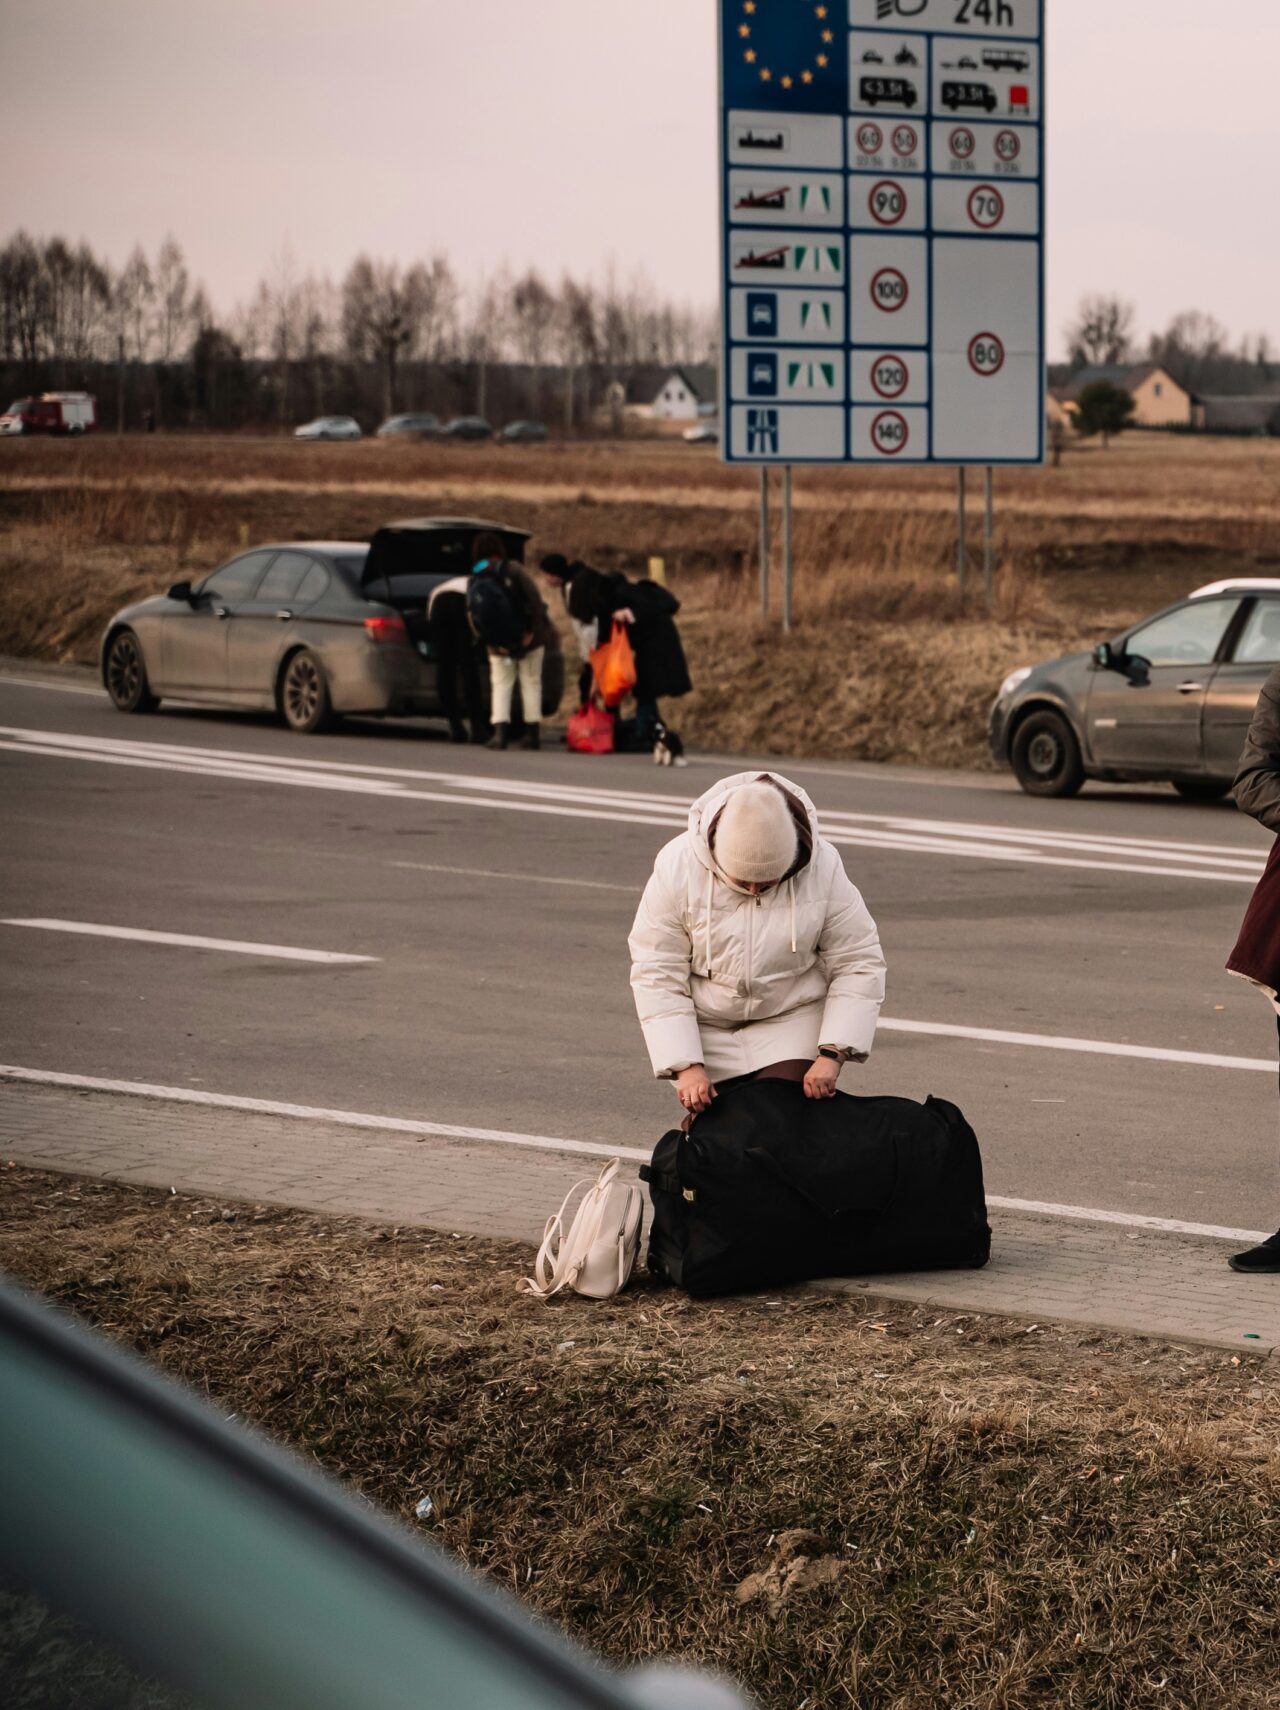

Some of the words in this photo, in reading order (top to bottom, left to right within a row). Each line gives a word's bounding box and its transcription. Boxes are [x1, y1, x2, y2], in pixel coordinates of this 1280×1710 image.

[954, 0, 1014, 27] 24h
[875, 192, 901, 214] 90
[976, 196, 999, 217] 70
[877, 281, 904, 299] 100
[975, 344, 998, 364] 80
[877, 368, 904, 386] 120
[877, 424, 904, 442] 140
